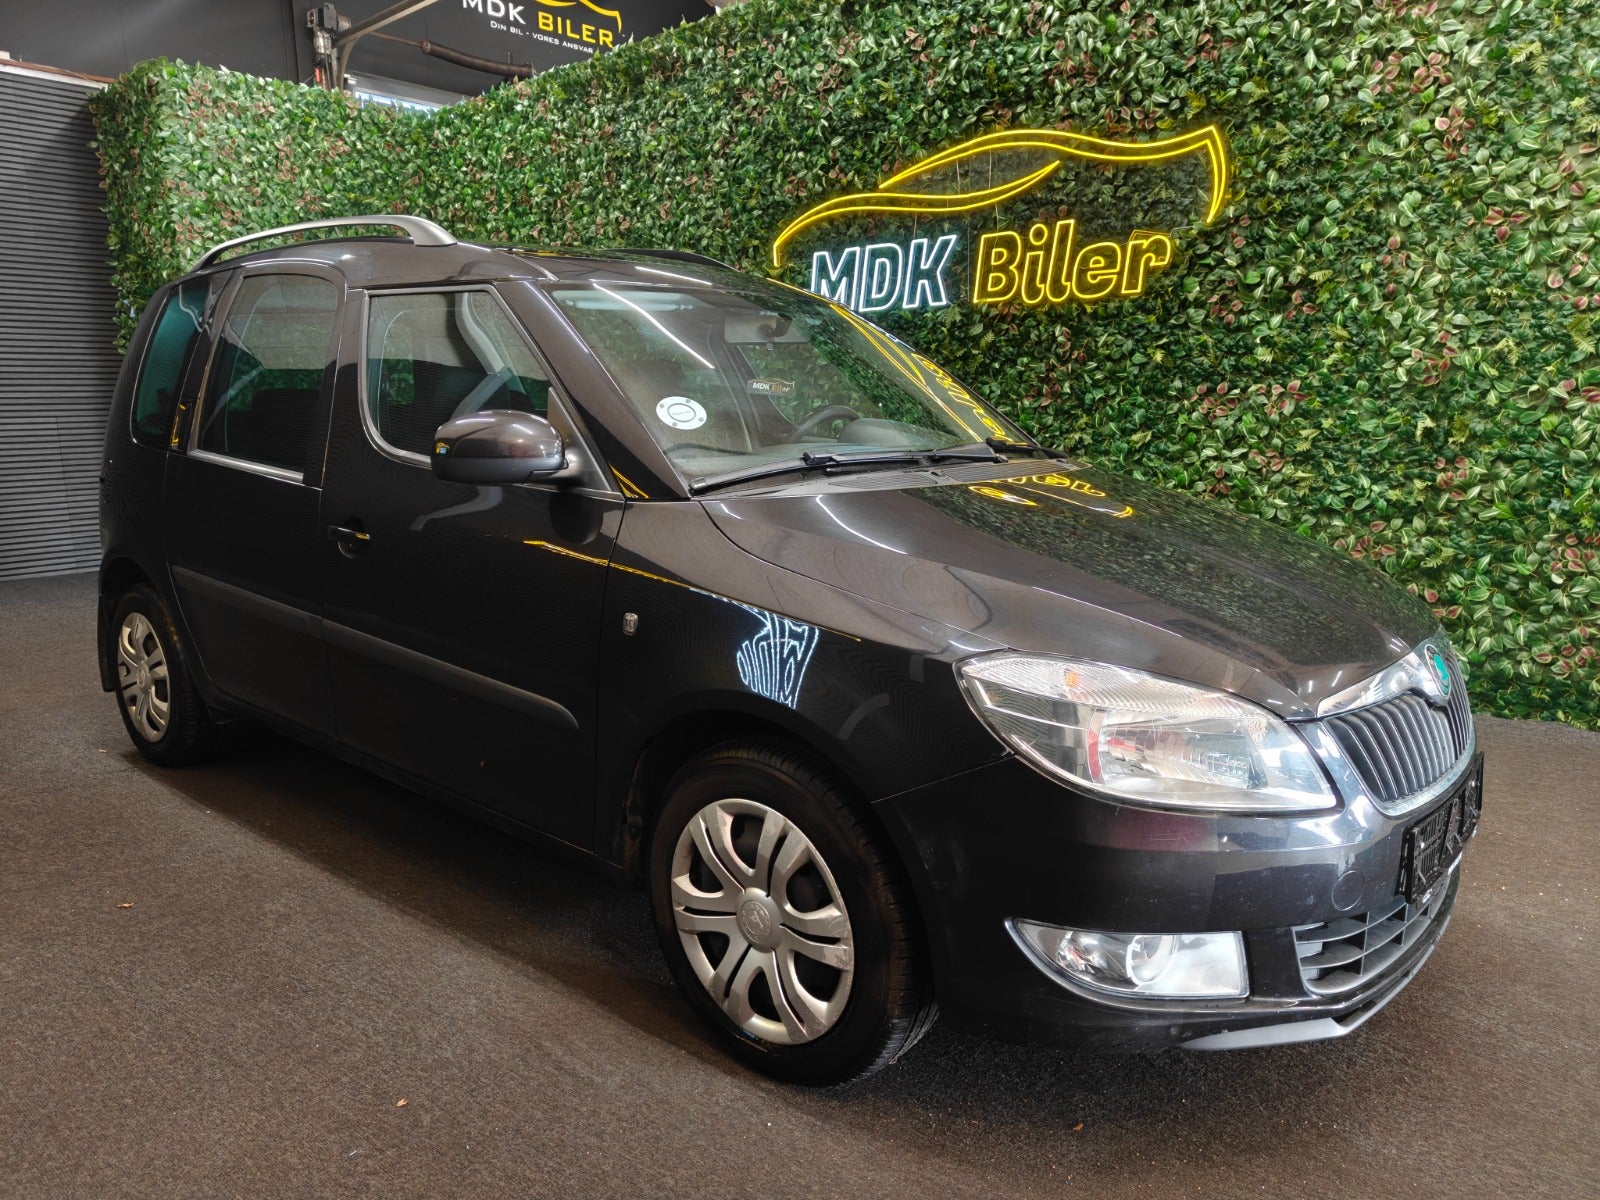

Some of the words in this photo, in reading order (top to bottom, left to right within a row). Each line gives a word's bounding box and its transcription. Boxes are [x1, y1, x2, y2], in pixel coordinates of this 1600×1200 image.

[463, 0, 526, 25] MDK
[538, 11, 614, 48] BILER
[510, 26, 523, 35] BIL
[532, 33, 559, 45] VORES
[562, 41, 594, 54] ANSVAR
[811, 234, 957, 312] MDK
[973, 219, 1172, 304] Biler
[752, 382, 770, 391] MDK
